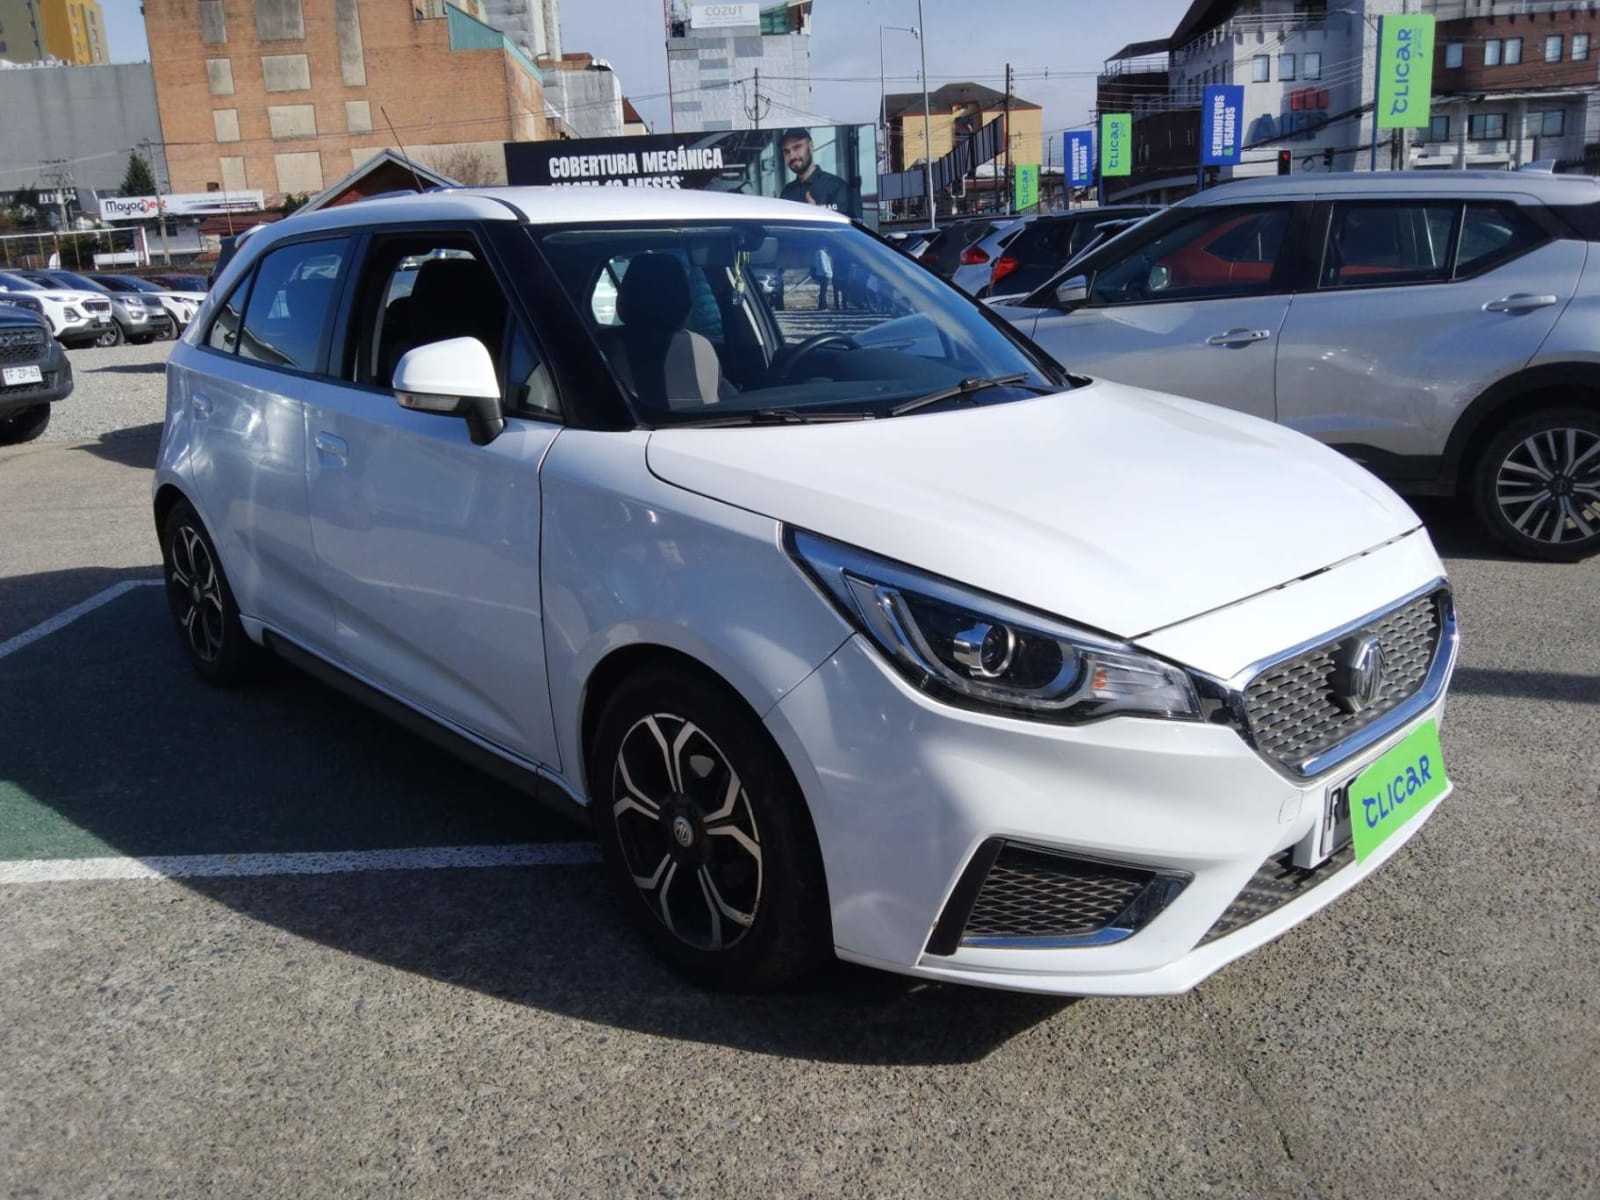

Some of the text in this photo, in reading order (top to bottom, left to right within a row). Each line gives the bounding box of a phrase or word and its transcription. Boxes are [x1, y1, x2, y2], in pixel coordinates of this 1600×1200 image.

[704, 5, 745, 17] COZUT
[1212, 94, 1225, 157] SEMINUEVOS
[1223, 106, 1236, 156] & USADOS
[549, 145, 724, 178] COBERTURA MECÁNICA
